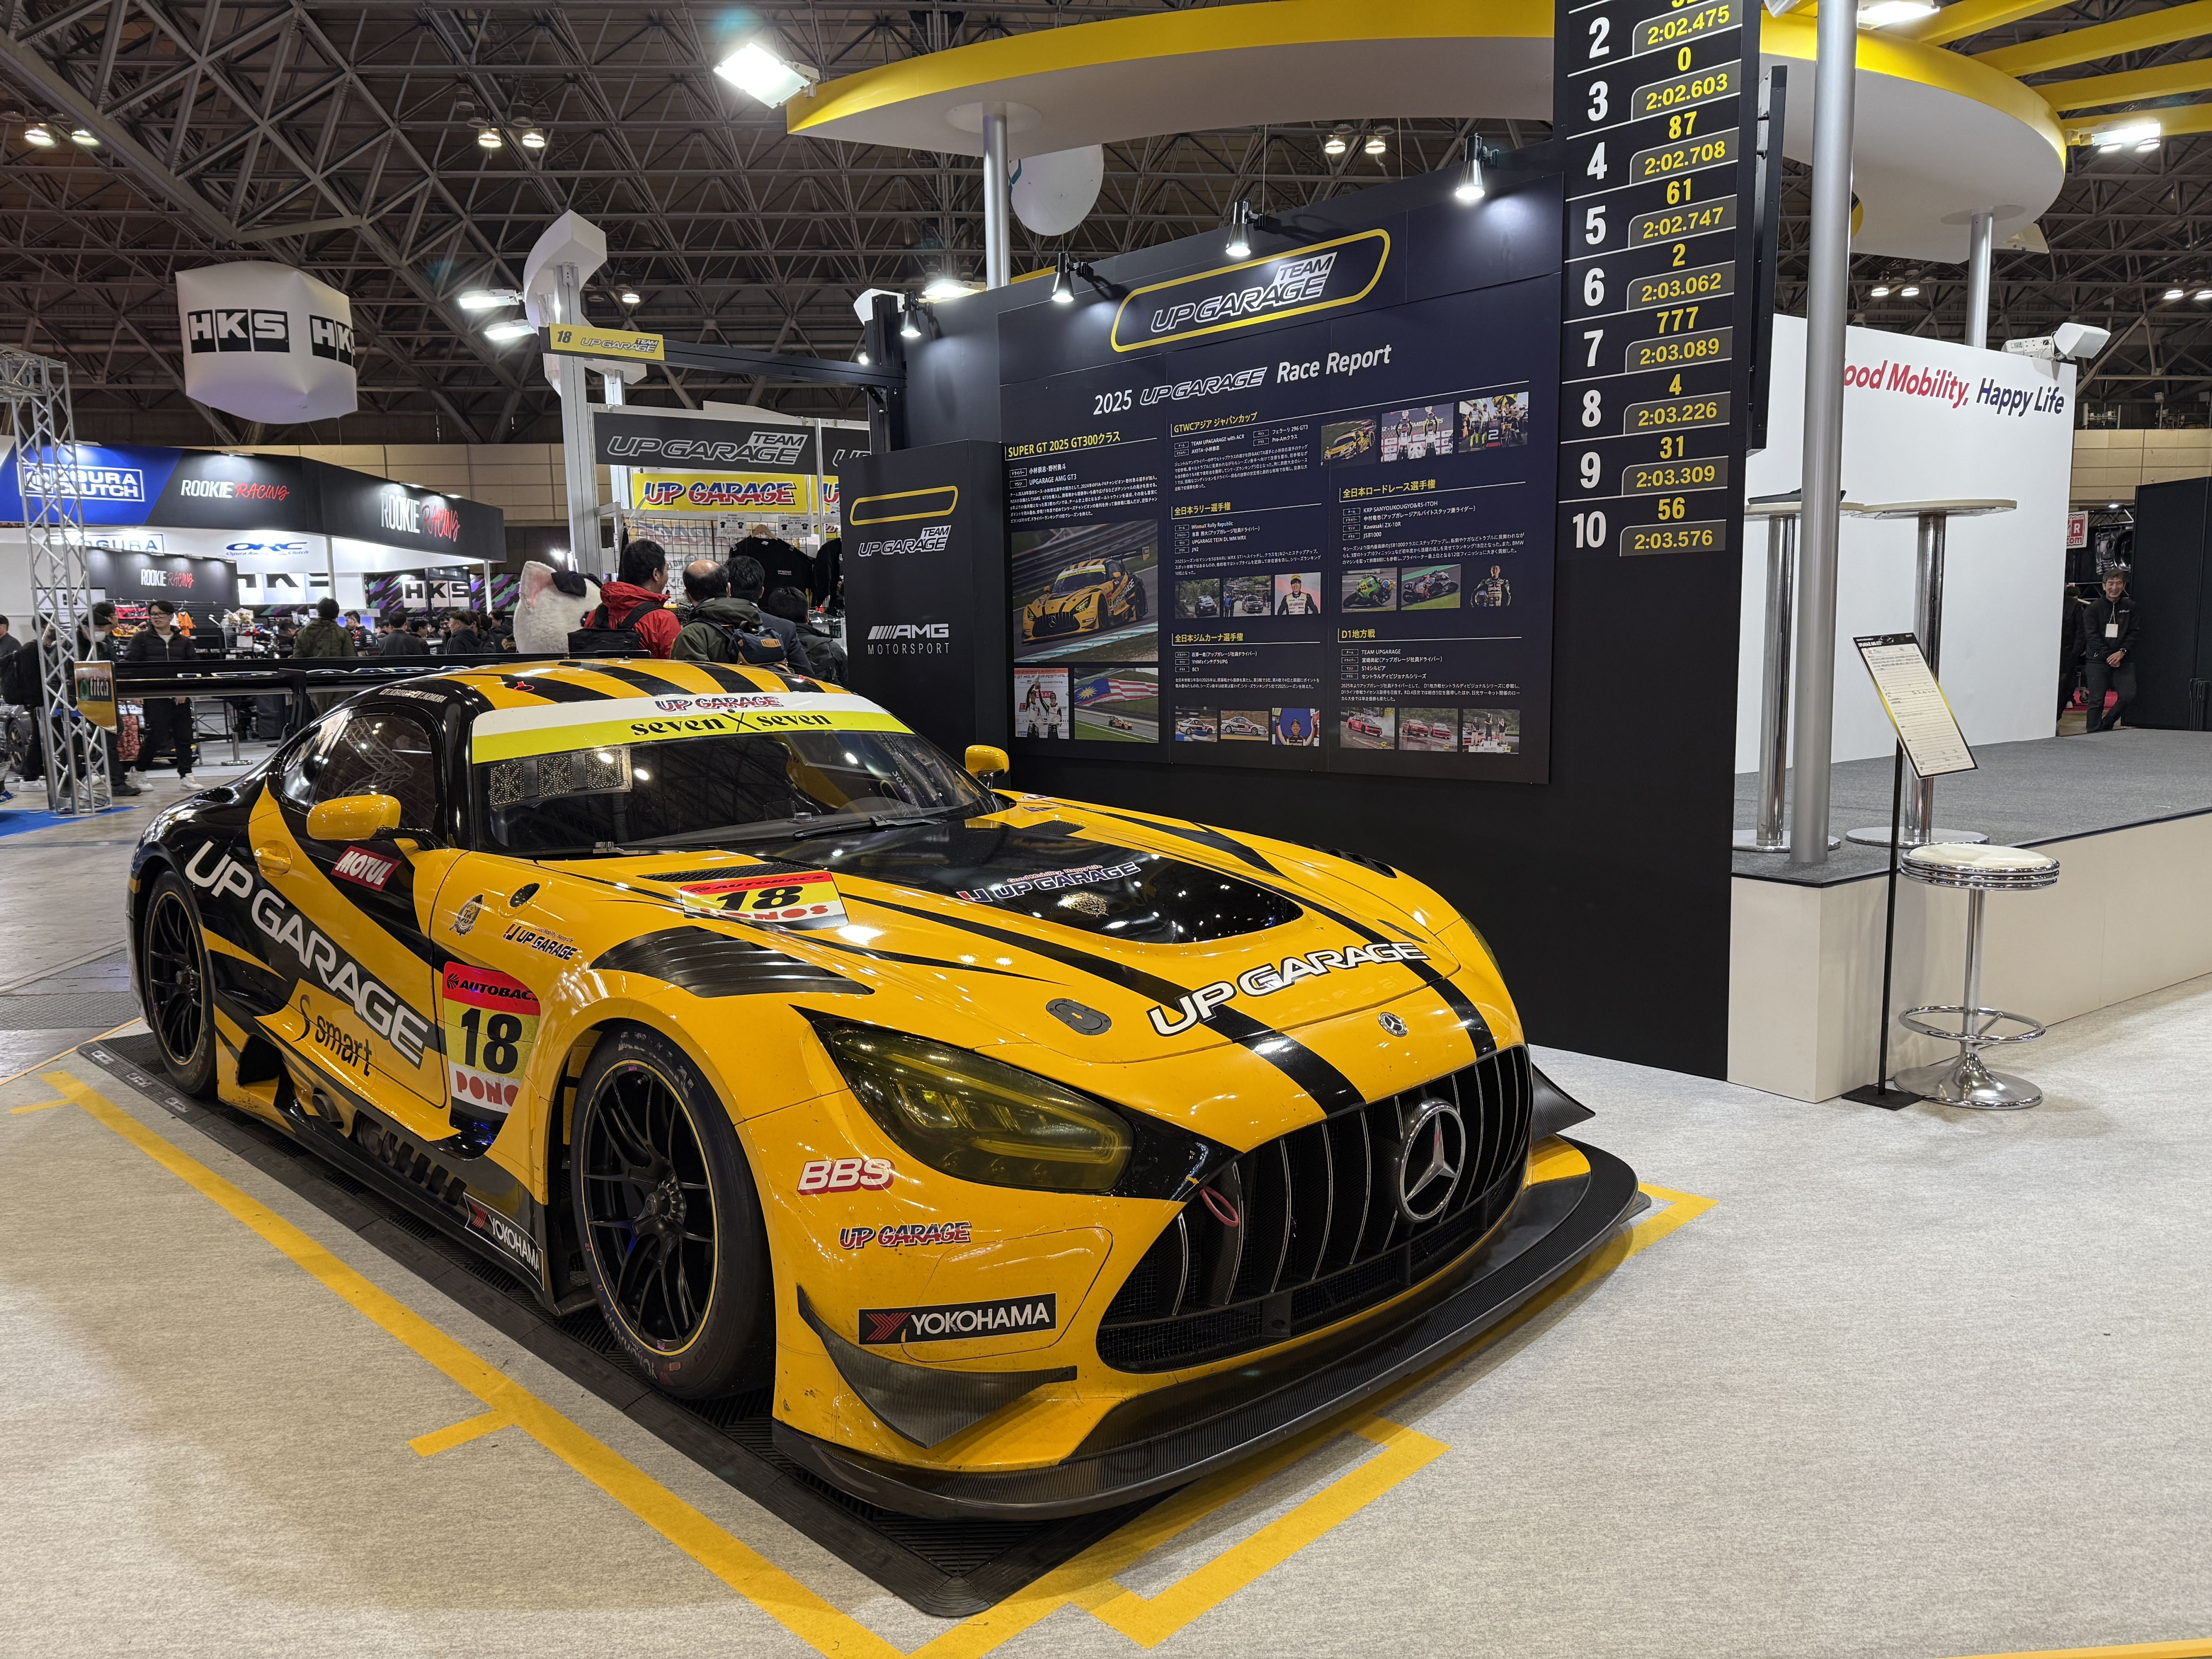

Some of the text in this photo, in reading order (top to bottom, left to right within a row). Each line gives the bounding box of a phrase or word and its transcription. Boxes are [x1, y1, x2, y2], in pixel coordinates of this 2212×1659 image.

[1589, 17, 1610, 59] 2
[1647, 5, 1730, 45] 2:02.475
[1677, 47, 1691, 71] 0
[1588, 81, 1608, 122] 3
[1646, 73, 1728, 110] 2:02.603
[1669, 111, 1697, 139] 87
[1587, 142, 1607, 180] 4
[1644, 141, 1725, 175] 2:02.708
[1667, 178, 1691, 204] 61
[1586, 206, 1606, 244] 5
[1643, 207, 1724, 239] 2:02.747
[1281, 255, 1333, 278] TEAM
[1672, 243, 1686, 266] 2
[1584, 268, 1605, 306] 6
[1641, 273, 1722, 302] 2:03.062
[189, 312, 287, 340] HKS
[1657, 306, 1699, 334] 777
[557, 330, 572, 344] 18
[636, 338, 658, 347] TEAM
[1584, 329, 1603, 367] 7
[1640, 338, 1719, 365] 2:03.089
[1094, 389, 1132, 415] 2025
[1277, 360, 1319, 383] Race
[1326, 344, 1392, 376] Report
[1669, 374, 1682, 395] 4
[1844, 360, 2065, 417] ood Mobility, Happy Life
[1582, 390, 1601, 427] 8
[1638, 402, 1717, 426] 2:03.226
[1174, 412, 1258, 433] GTWCアジア ジャパンカップ
[1488, 429, 1499, 440] 2
[752, 433, 805, 448] TEAM
[1008, 431, 1121, 457] SUPER GT 2025 GT300クラス
[1660, 435, 1683, 459] 31
[1029, 477, 1054, 486] UPGARAGE
[1580, 452, 1600, 488] 9
[1636, 465, 1715, 488] 2:03.309
[181, 480, 289, 501] ROOKIE RACING
[643, 481, 799, 507] UP GARAGE
[1343, 479, 1436, 499] 全日本ロードレース選手権
[381, 493, 460, 542] ROOKIE RACING
[1174, 501, 1231, 516] 全日本ラリー選手権
[1658, 497, 1685, 520] 56
[924, 526, 950, 536] TEAM
[1573, 511, 1606, 548] 10
[1635, 529, 1713, 550] 2:03.576
[141, 569, 194, 588] ROOKIE RACING
[405, 582, 469, 599] HKS
[892, 624, 949, 640] AMG
[1175, 633, 1243, 642] 全日本ジムカーナ選手権
[1341, 629, 1376, 639] D1地方戦
[868, 643, 949, 655] MOTORSPORT
[655, 696, 784, 712] UP GARAGE
[630, 711, 834, 736] seven seven
[334, 850, 393, 886] MOTUL
[992, 861, 1141, 899] UP GARAGE
[712, 876, 824, 890] AUTOBACS
[716, 886, 803, 911] 18
[516, 930, 578, 960] UP GARAGE
[459, 980, 537, 1001] AUTOBAC
[315, 1014, 372, 1077] smart
[461, 1007, 522, 1074] 18
[796, 1158, 894, 1195] BBS
[488, 1214, 540, 1276] YOKOHAMA
[839, 1221, 972, 1249] UP GARAGE
[911, 1302, 1050, 1335] YOKOHAMA
